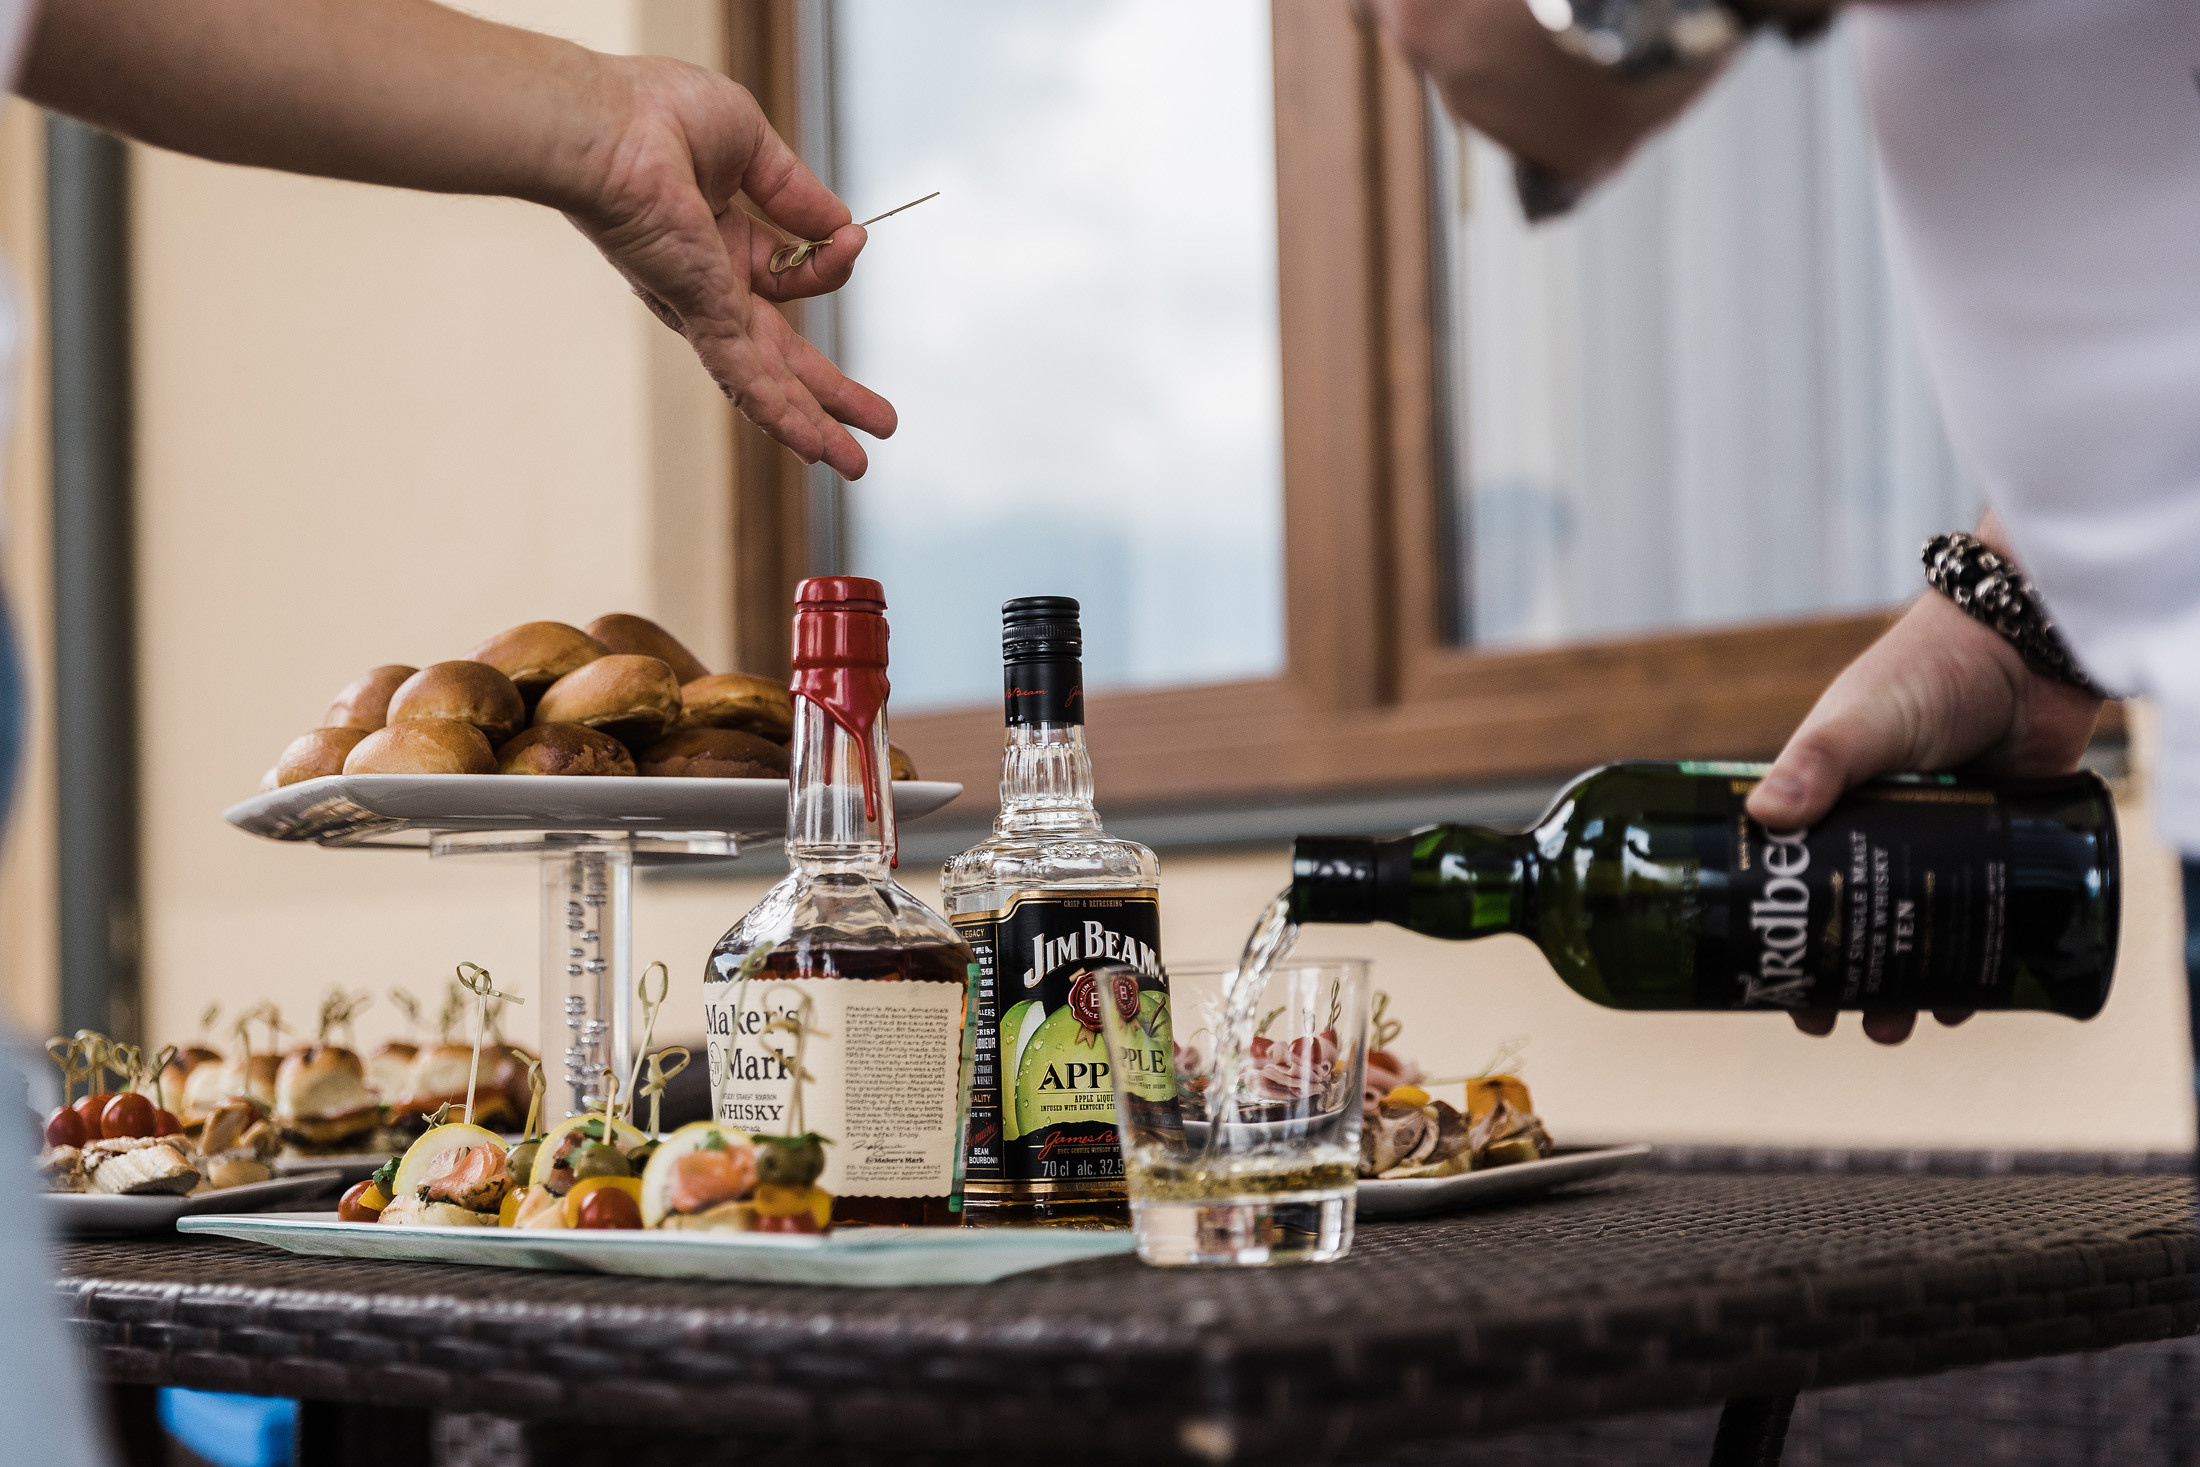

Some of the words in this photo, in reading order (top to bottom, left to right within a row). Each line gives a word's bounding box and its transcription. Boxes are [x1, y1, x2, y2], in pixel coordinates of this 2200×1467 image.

[1850, 831, 1867, 884] MALT
[1874, 847, 1889, 927] WHISKY
[962, 929, 984, 938] LEGACY
[1850, 888, 1867, 962] SINGLE
[1896, 900, 1914, 954] TEN
[1024, 932, 1079, 988] JIM
[1083, 920, 1159, 979] BEAM
[1866, 933, 1887, 993] SCOTCH
[1080, 982, 1090, 996] JIM
[1080, 1002, 1099, 1019] SINCE
[724, 1048, 795, 1080] Mark
[1037, 1062, 1112, 1090] APP
[720, 1104, 783, 1120] WHISKY
[971, 1094, 991, 1102] ALITY
[1096, 1094, 1114, 1102] LIQUE
[1038, 1131, 1098, 1160] James
[1042, 1161, 1057, 1177] 70
[1060, 1160, 1069, 1177] cl
[1077, 1160, 1097, 1176] alc.
